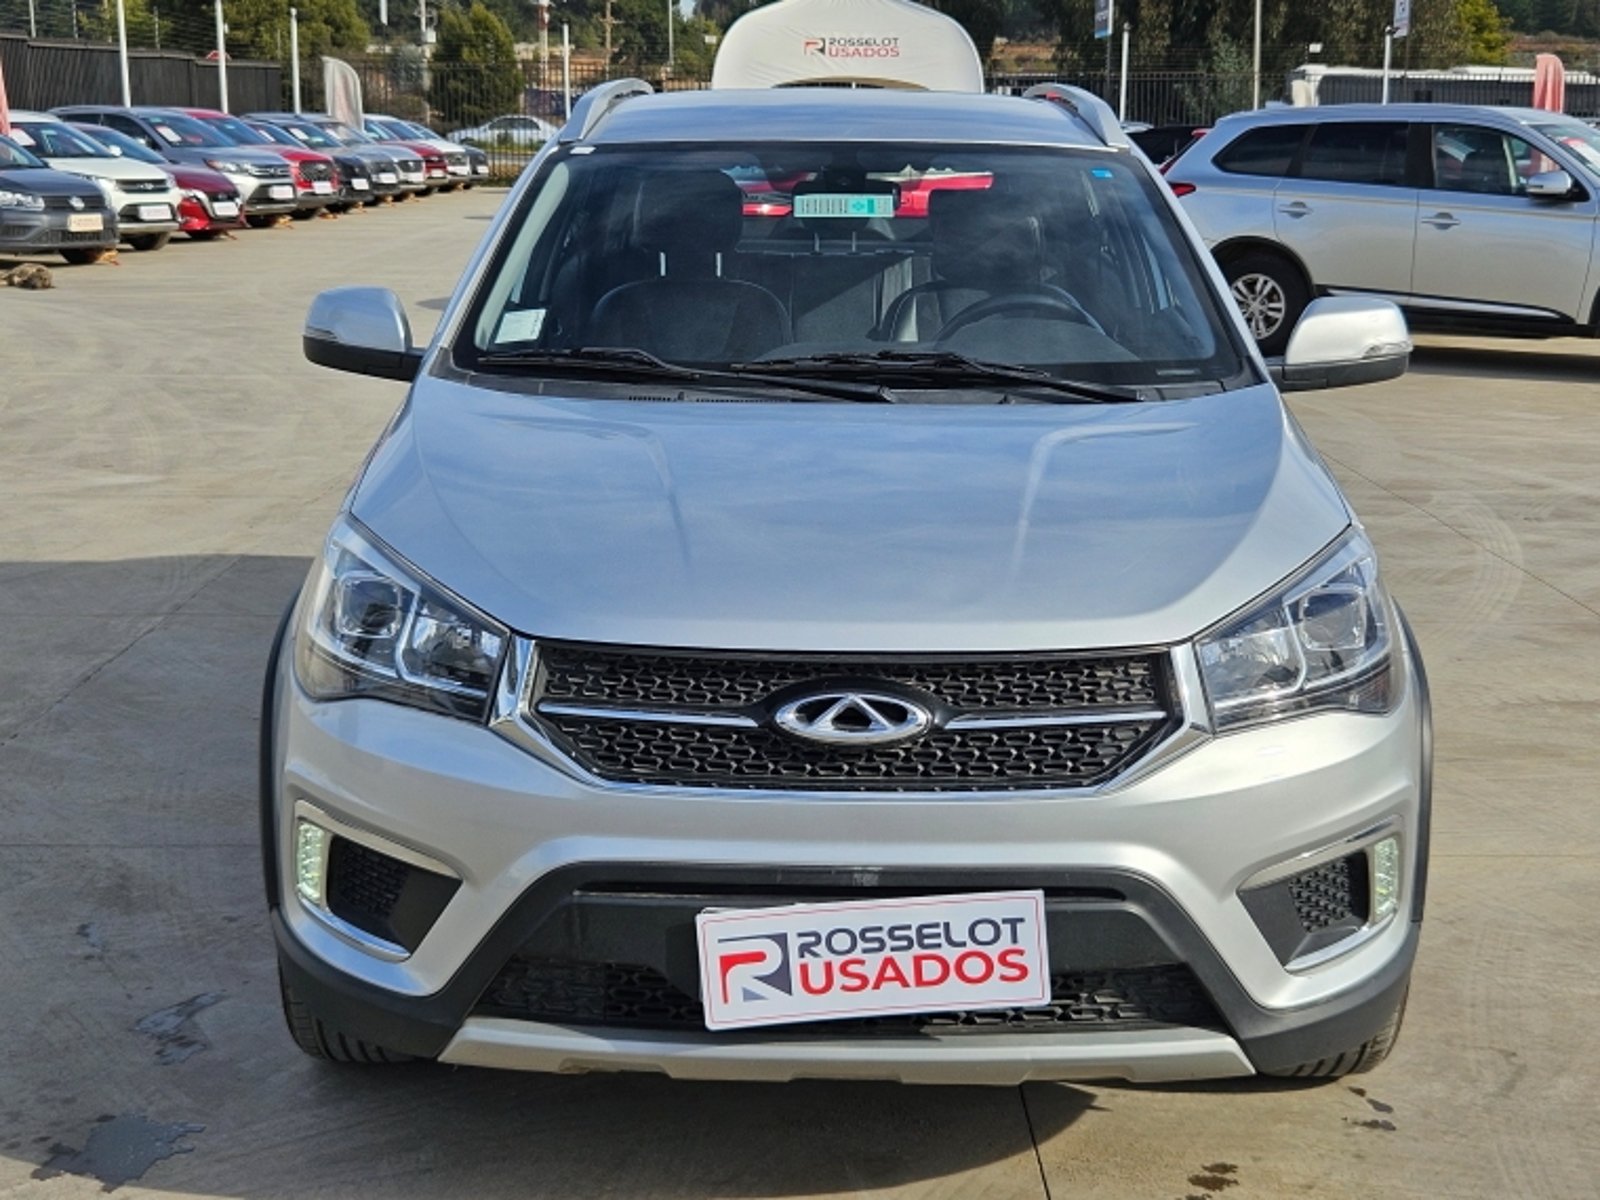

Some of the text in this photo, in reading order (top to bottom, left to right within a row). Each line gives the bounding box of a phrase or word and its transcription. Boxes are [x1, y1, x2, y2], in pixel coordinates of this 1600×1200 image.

[828, 37, 900, 47] ROSSELOT
[828, 47, 900, 58] USADOS
[796, 917, 1026, 959] ROSSELOT
[799, 947, 1030, 996] USADOS
